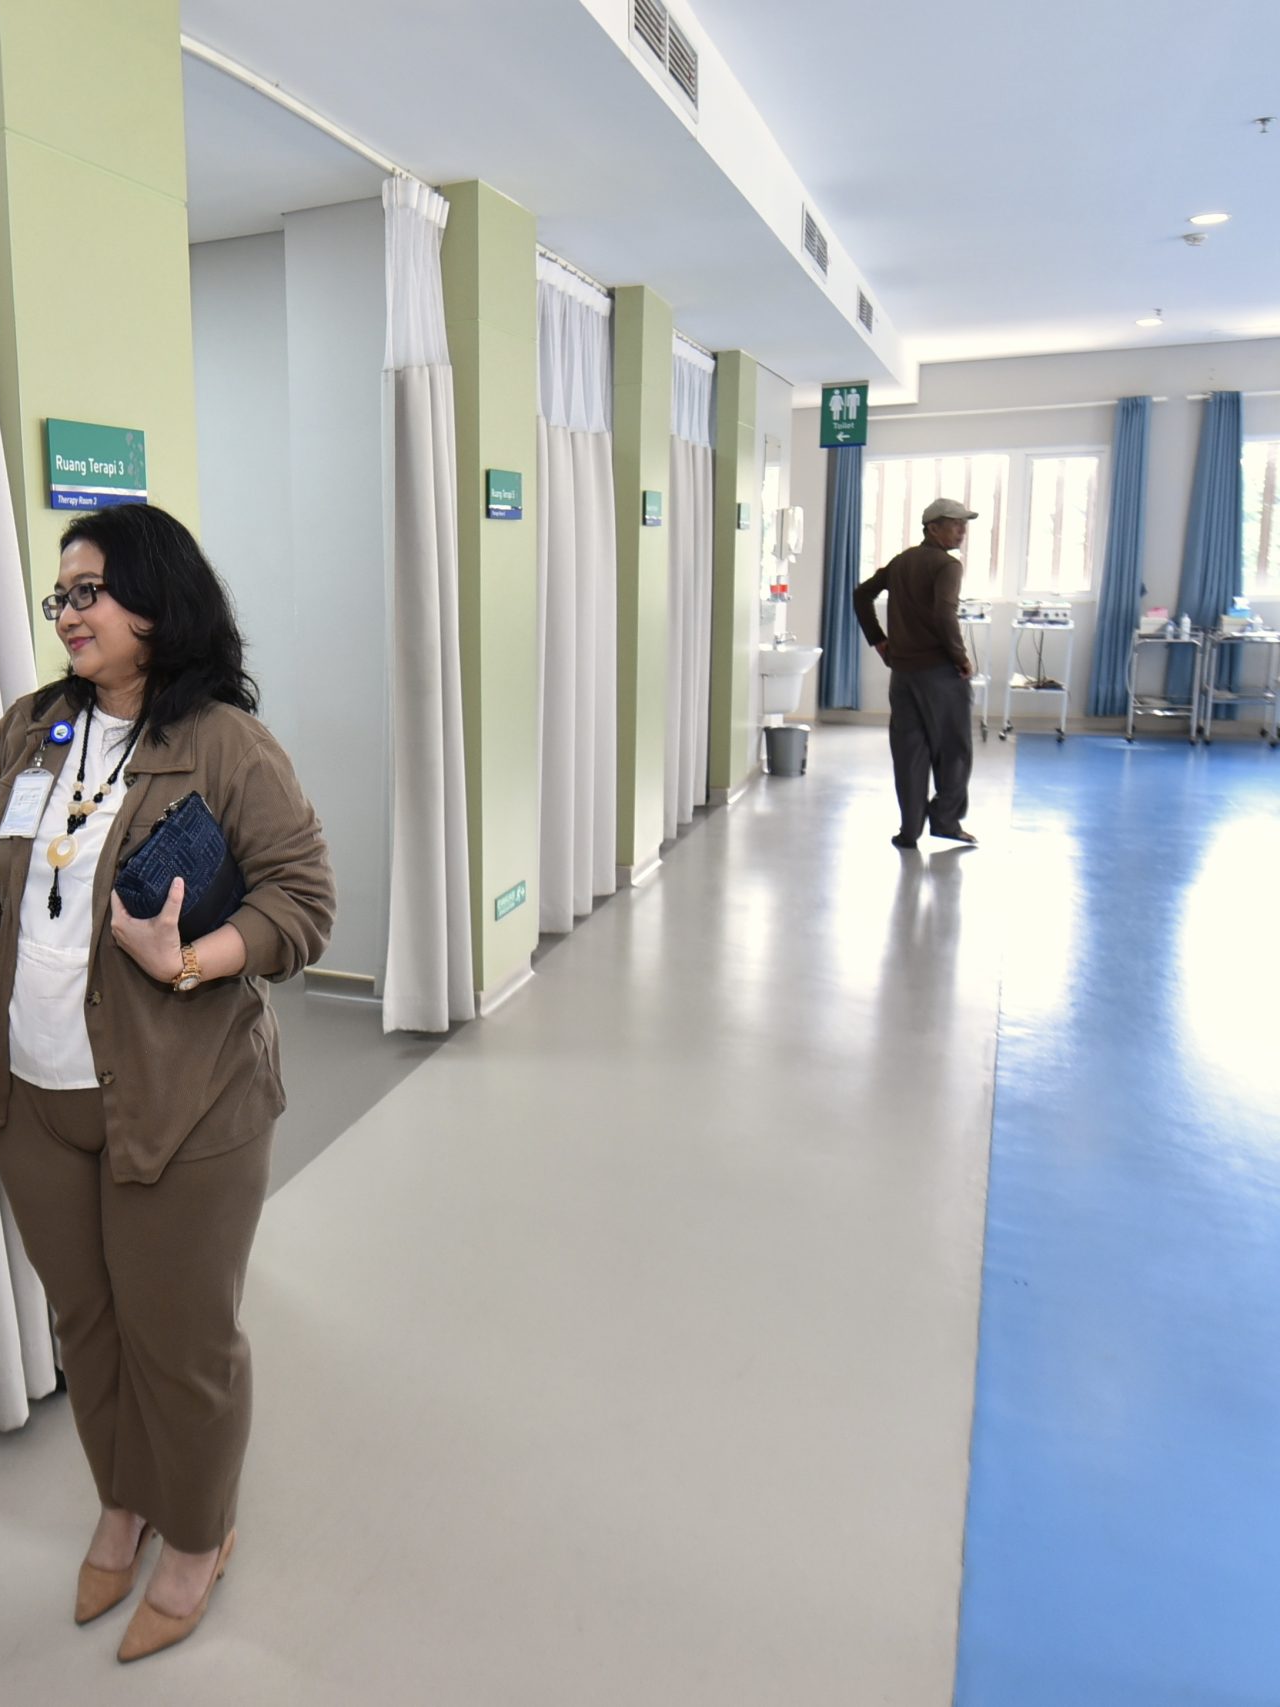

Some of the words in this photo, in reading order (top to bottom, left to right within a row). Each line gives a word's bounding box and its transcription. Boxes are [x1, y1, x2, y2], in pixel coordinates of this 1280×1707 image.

[55, 455, 87, 476] Ruang
[88, 458, 117, 478] Terapi
[118, 460, 124, 475] 3
[58, 494, 78, 506] Therapy
[79, 495, 93, 505] Room
